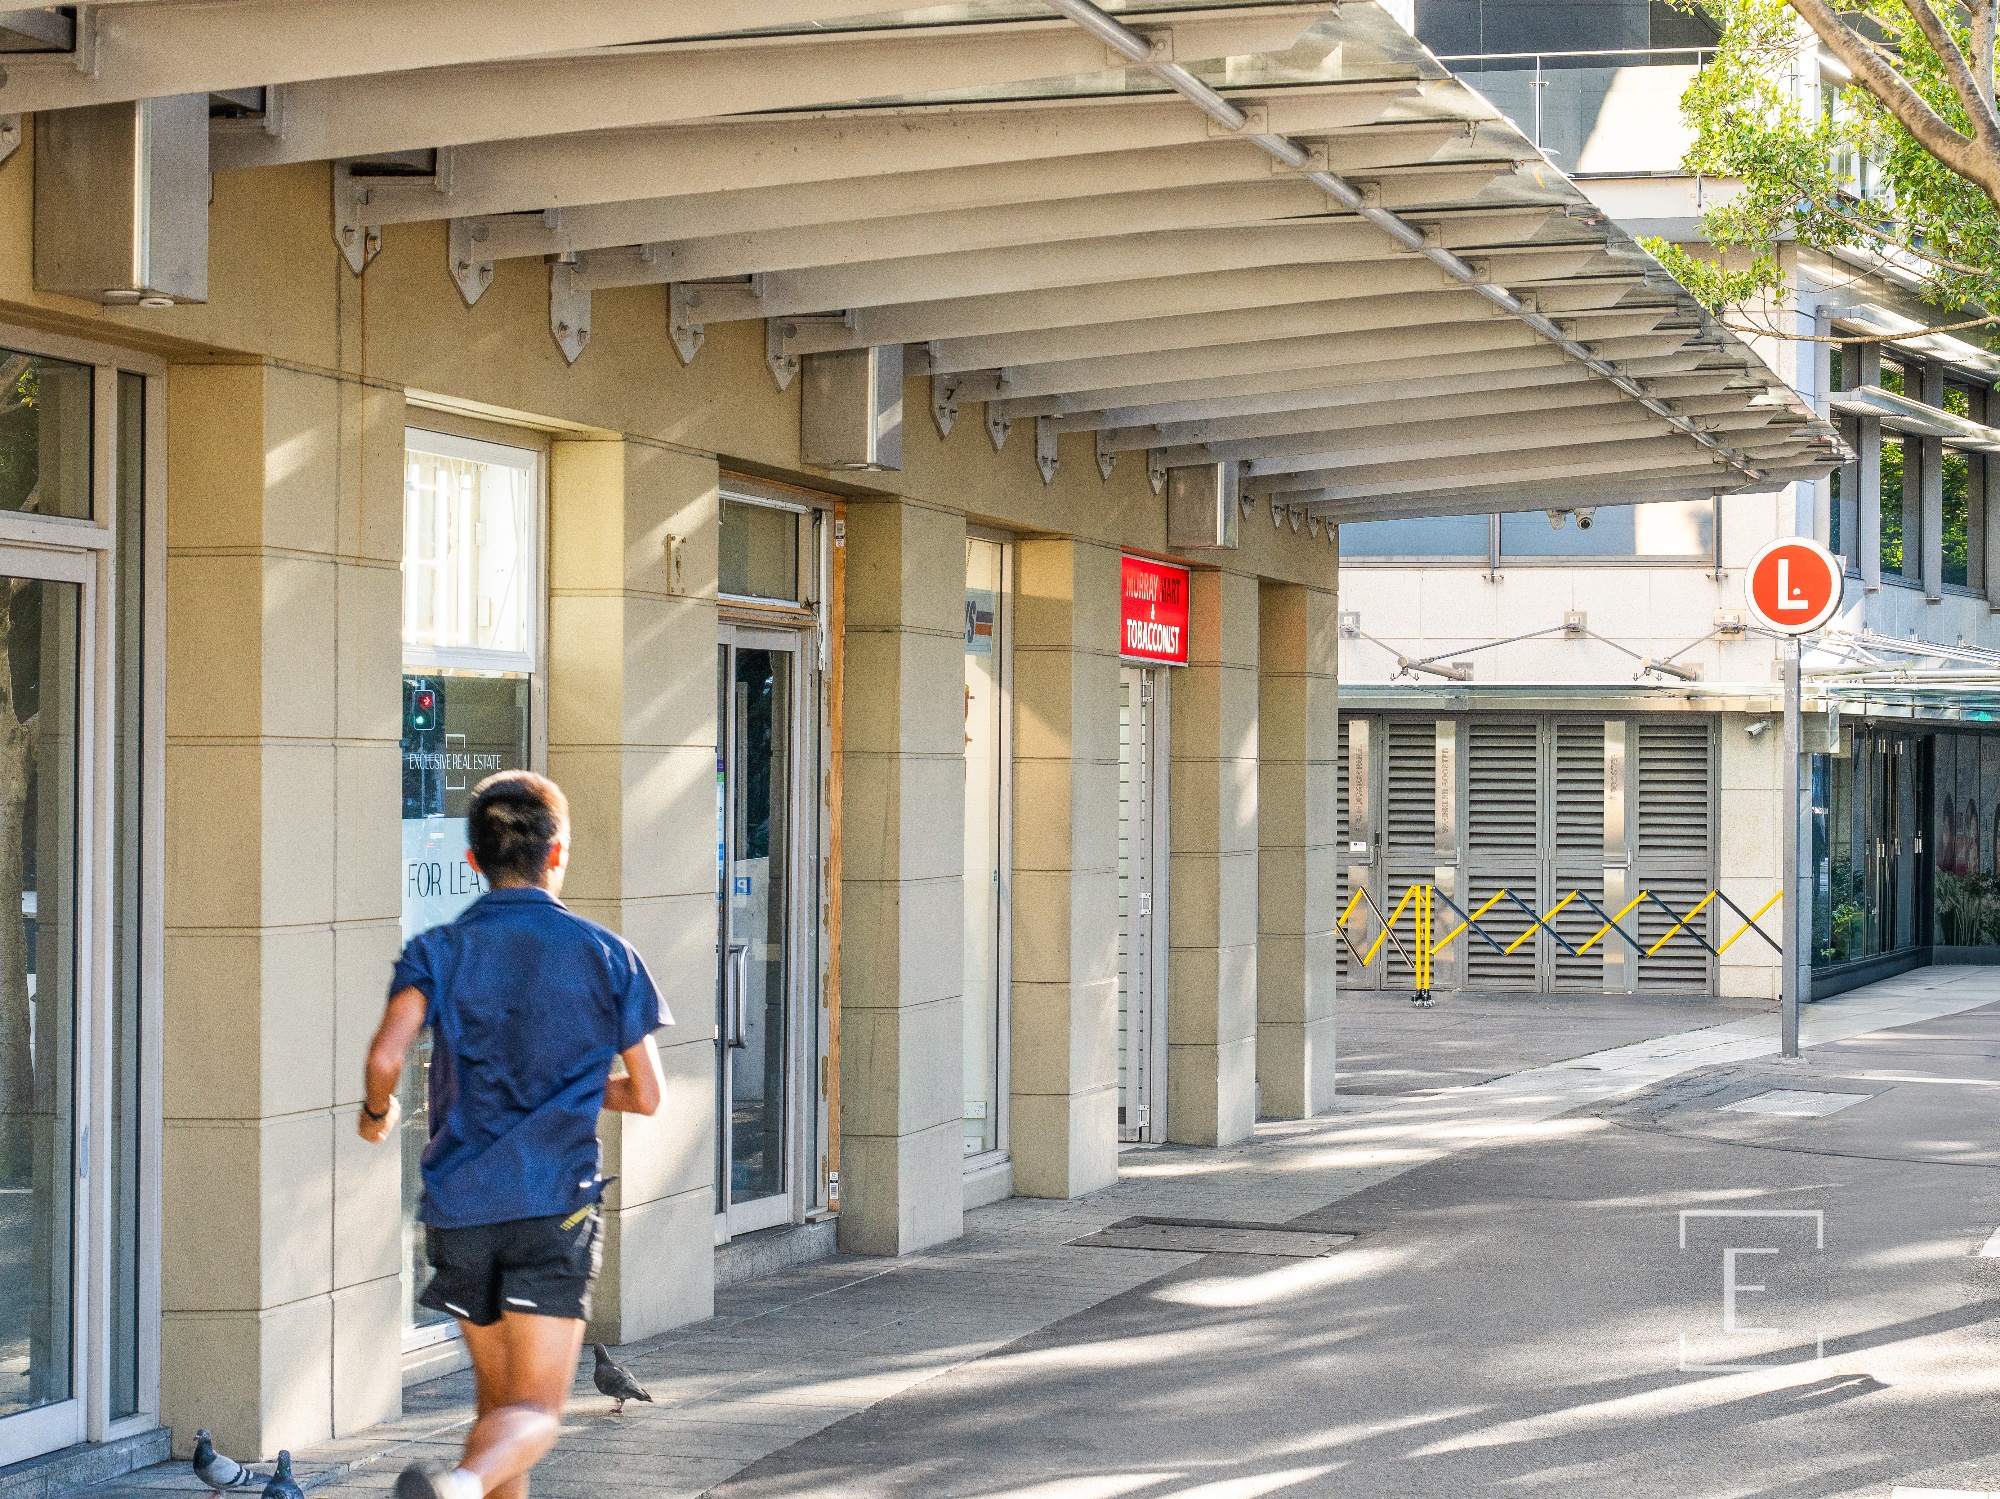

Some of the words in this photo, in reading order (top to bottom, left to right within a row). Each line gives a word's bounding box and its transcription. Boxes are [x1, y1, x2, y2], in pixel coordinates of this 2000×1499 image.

[1126, 568, 1158, 601] MURRAY
[1160, 576, 1181, 606] MART
[1777, 558, 1808, 610] L
[1150, 603, 1155, 620] &
[1126, 618, 1180, 655] TOBACCONIST
[409, 753, 452, 770] EXCLUSIVE
[453, 754, 472, 770] REAL
[473, 754, 502, 770] ESTATE
[408, 862, 442, 898] FOR
[450, 861, 490, 895] LEA
